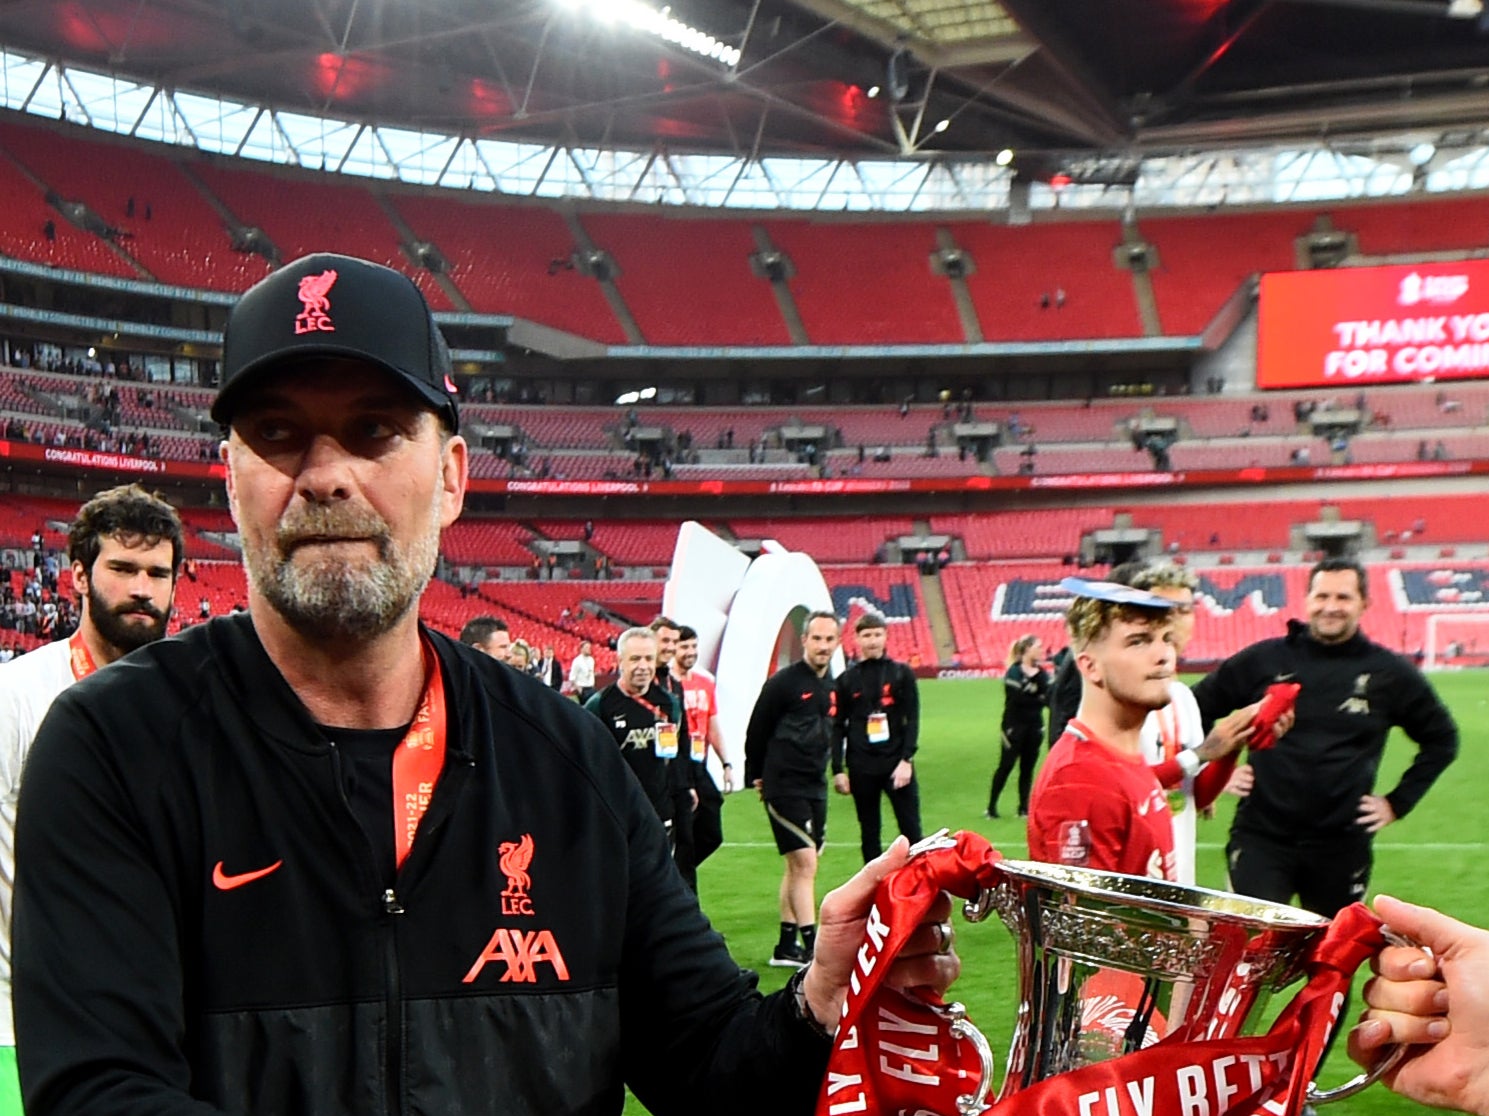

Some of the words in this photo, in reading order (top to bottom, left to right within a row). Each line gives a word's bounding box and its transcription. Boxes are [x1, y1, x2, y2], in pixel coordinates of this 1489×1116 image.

[1334, 318, 1446, 346] THANK
[1325, 349, 1388, 377] FOR
[45, 447, 118, 469] CONGRATULATIONS
[119, 456, 159, 472] LIVERPOOL
[507, 481, 590, 492] CONGRATULATIONS
[591, 481, 639, 492] LIVERPOOL
[462, 928, 570, 983] AXA
[878, 1006, 940, 1087] FLY
